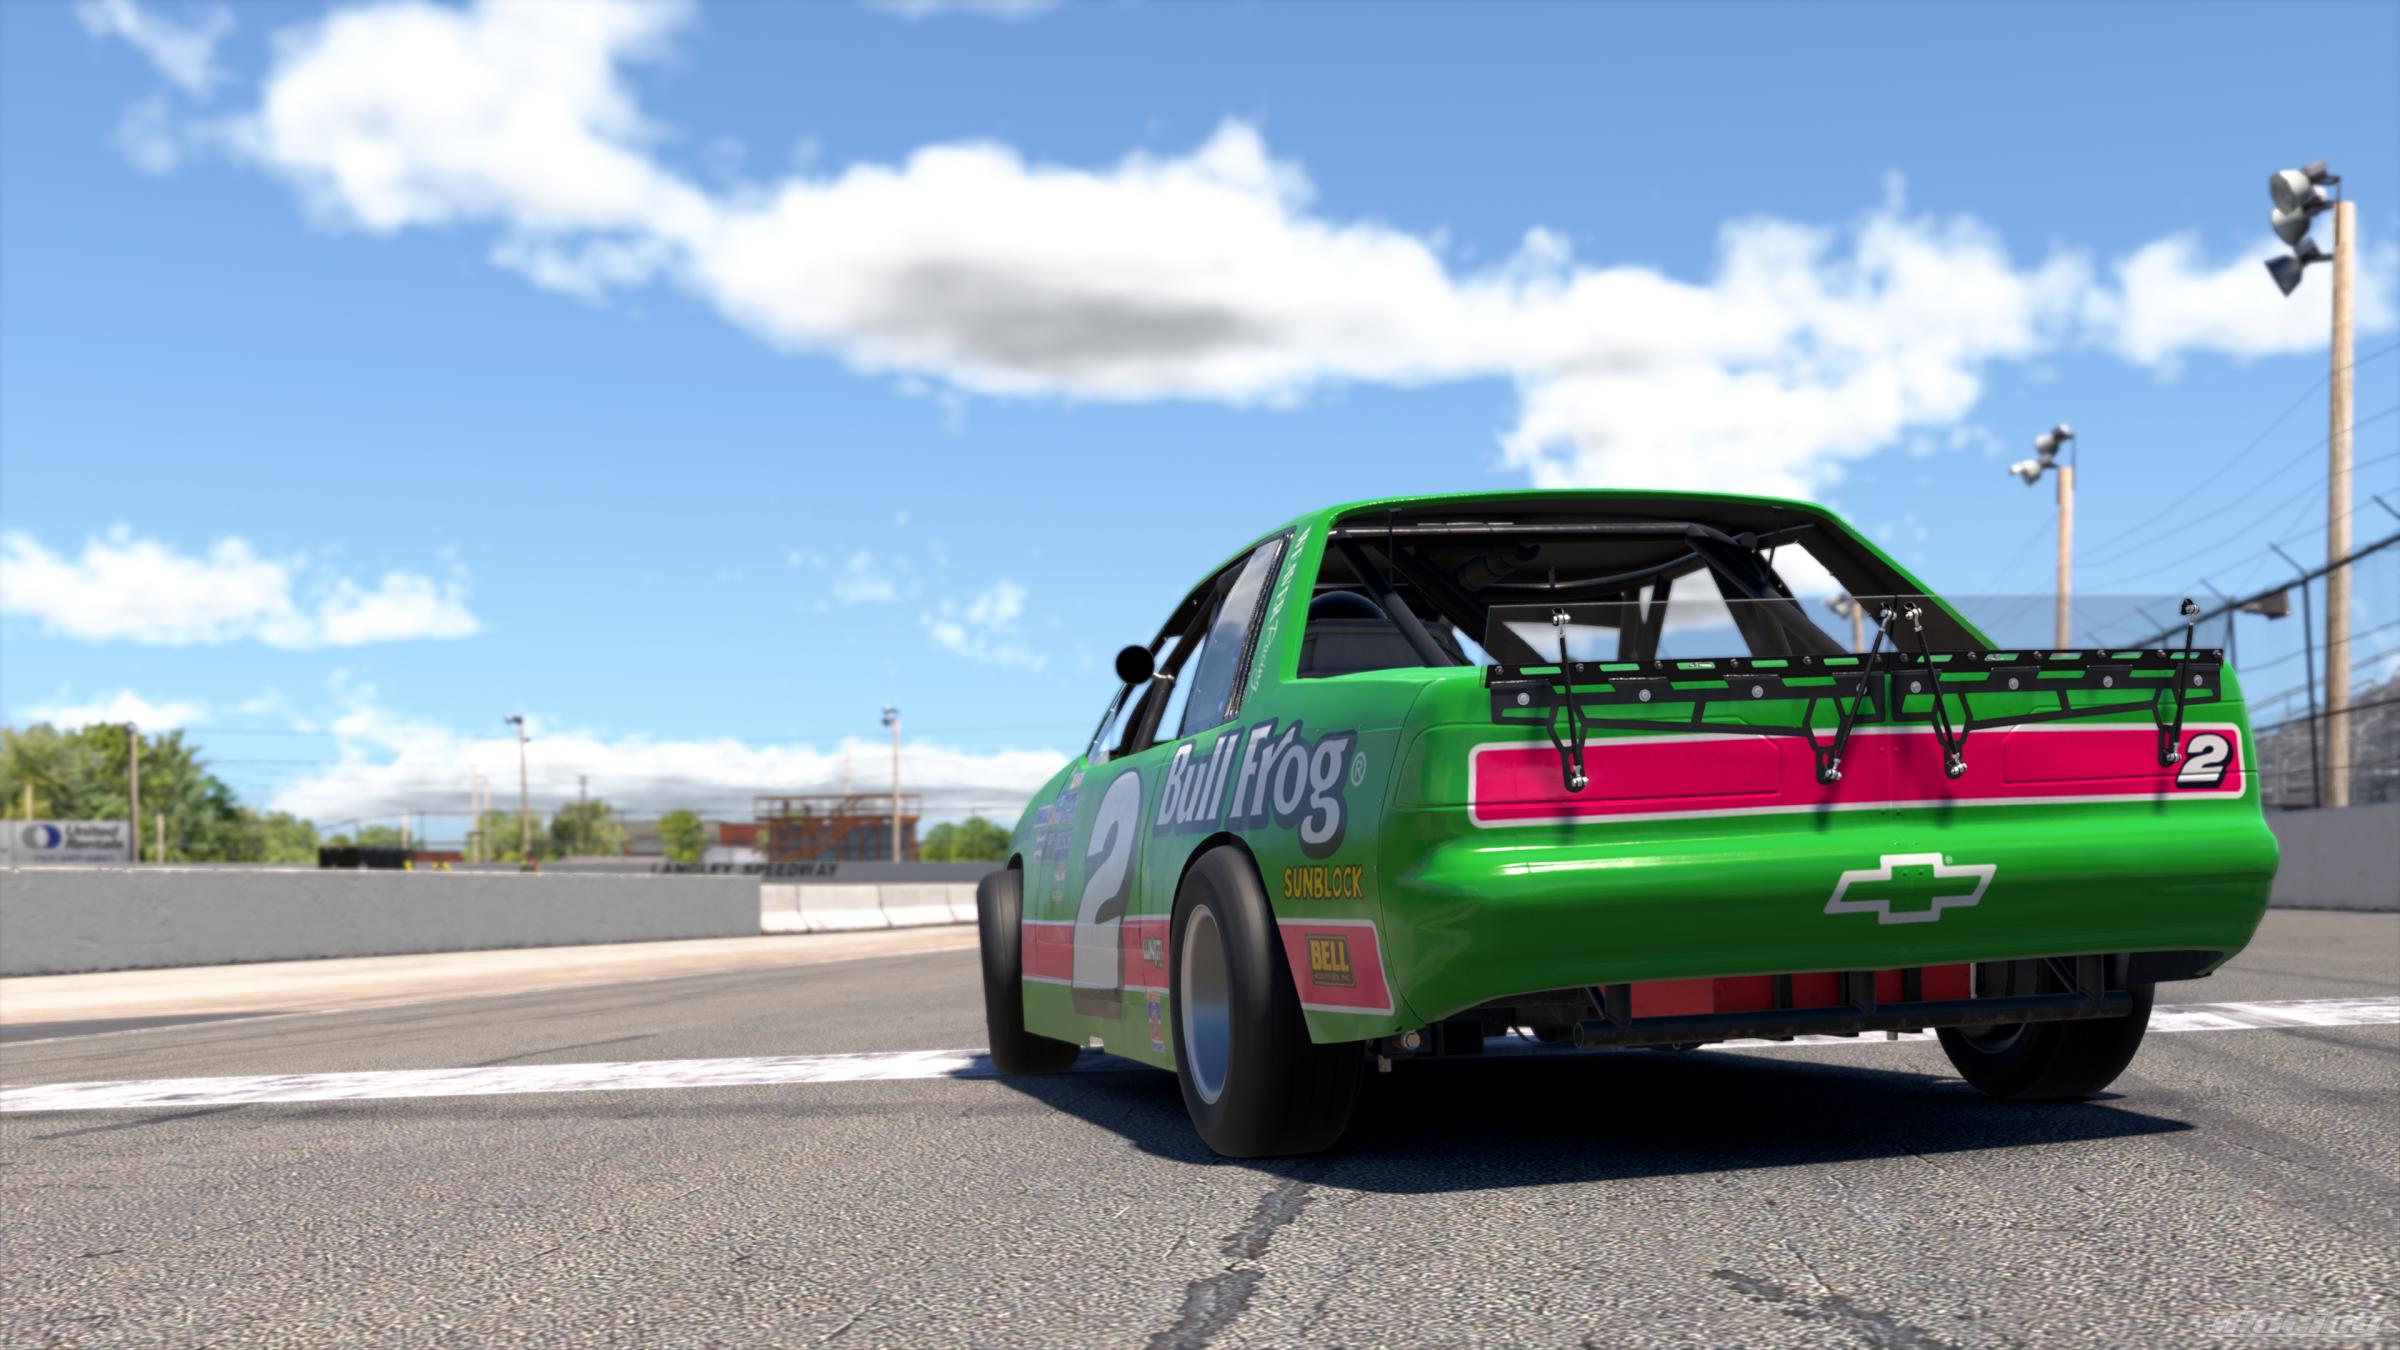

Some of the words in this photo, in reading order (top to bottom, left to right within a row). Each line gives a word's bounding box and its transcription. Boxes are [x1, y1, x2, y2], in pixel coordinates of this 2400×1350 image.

[1156, 728, 1240, 827] Bull
[1229, 723, 1350, 845] Frog
[2175, 733, 2234, 788] 2
[1072, 768, 1142, 992] 2
[1284, 864, 1364, 899] SUNBLOCK
[1310, 939, 1350, 972] BELL
